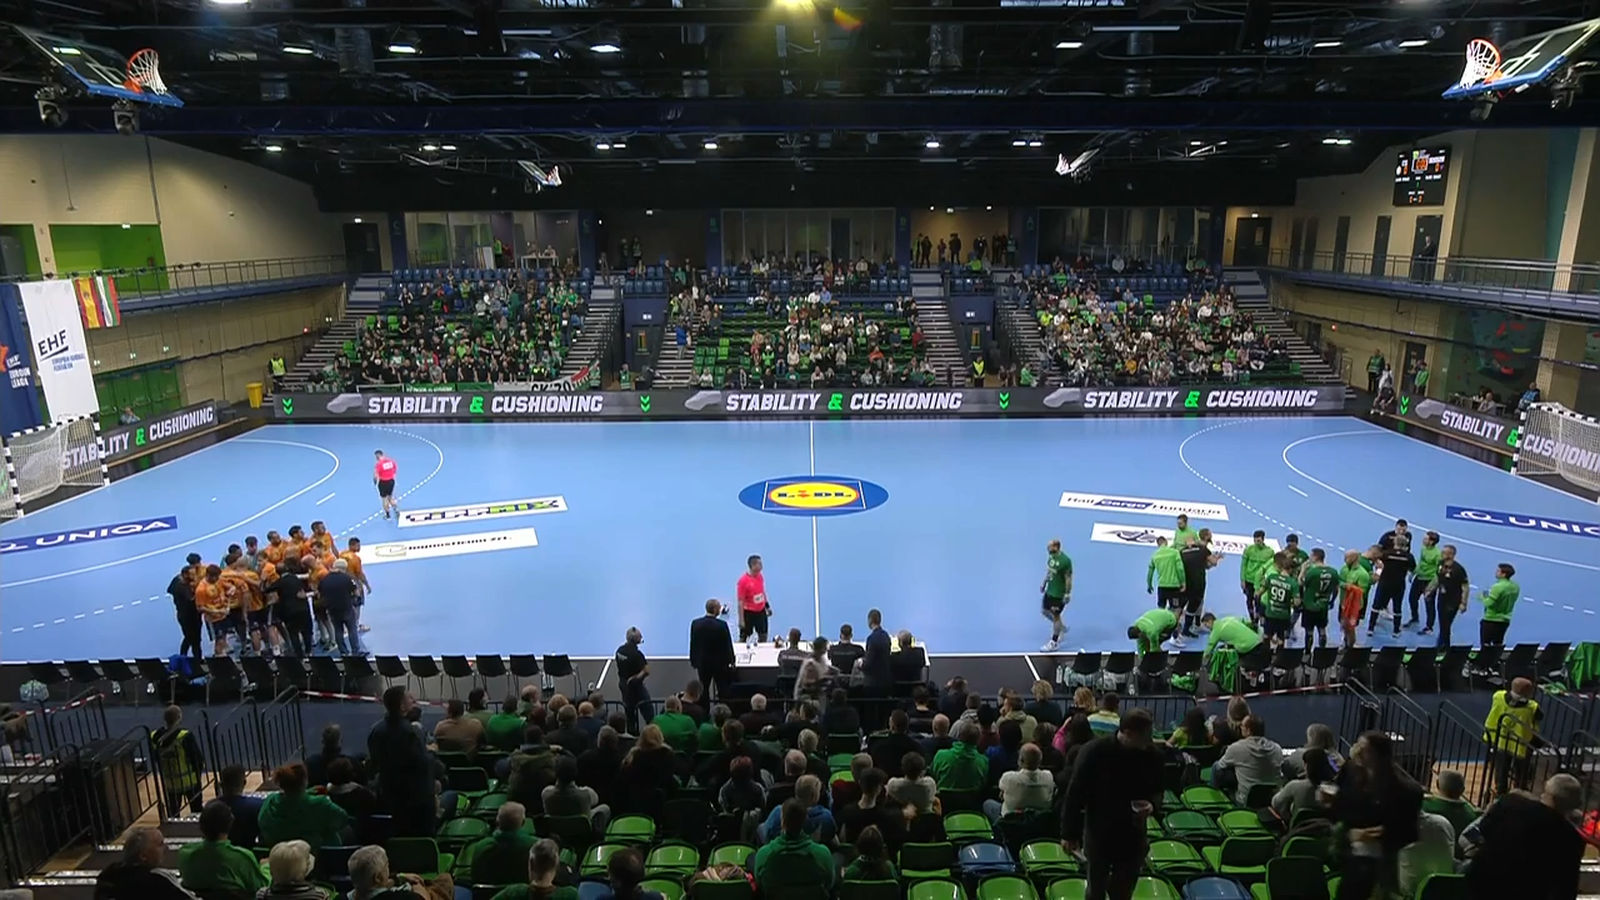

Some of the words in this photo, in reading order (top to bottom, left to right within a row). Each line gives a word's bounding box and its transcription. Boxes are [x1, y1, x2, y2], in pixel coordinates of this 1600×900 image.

[37, 329, 67, 357] EHF
[368, 396, 462, 414] STABILITY
[469, 395, 485, 414] &
[491, 396, 604, 413] CUSHIONING
[726, 393, 822, 411] STABILITY
[827, 393, 844, 411] &
[850, 393, 963, 410] CUSHIONING
[1083, 391, 1179, 408] STABILITY
[1184, 391, 1200, 408] &
[1206, 390, 1319, 408] CUSHIONING
[63, 432, 130, 468] STABLITY
[135, 428, 147, 446] &
[149, 406, 214, 441] CUSHIONING
[1441, 410, 1504, 441] STABILITY
[1506, 429, 1518, 447] &
[36, 520, 171, 546] UNIQA
[1271, 586, 1286, 602] 99
[1320, 580, 1331, 591] 17
